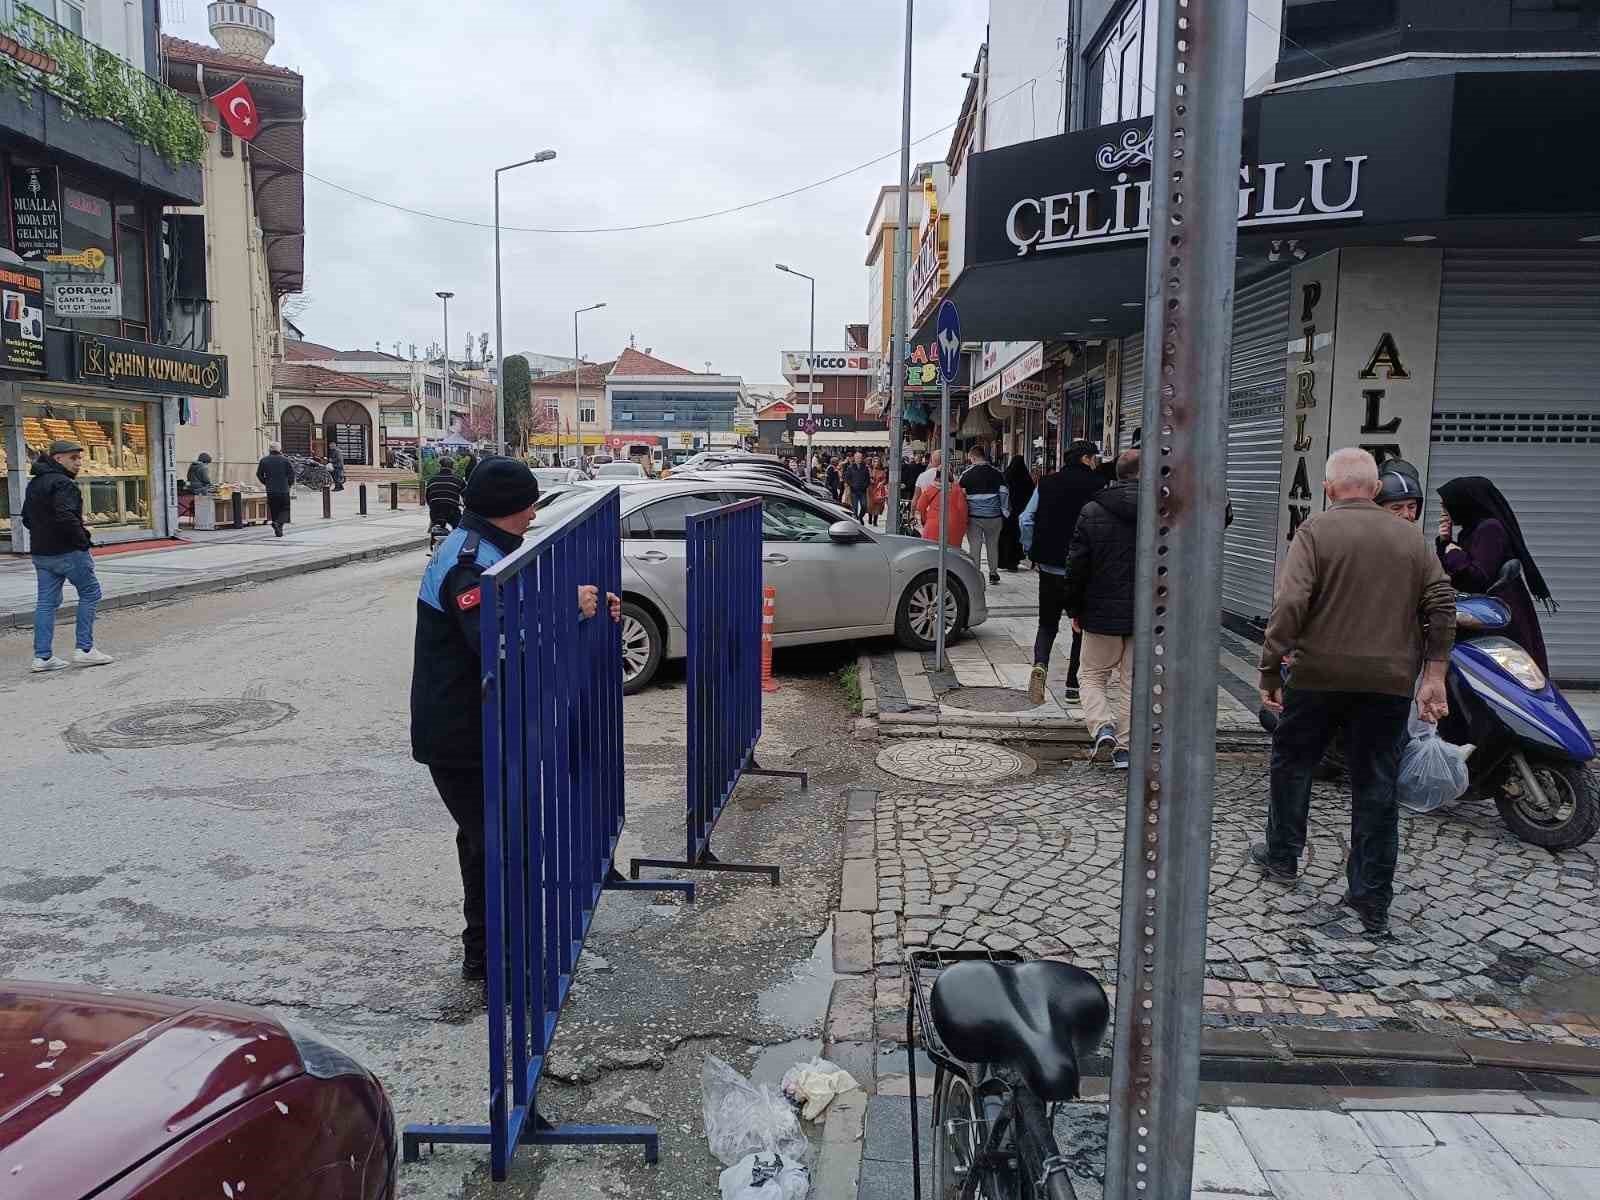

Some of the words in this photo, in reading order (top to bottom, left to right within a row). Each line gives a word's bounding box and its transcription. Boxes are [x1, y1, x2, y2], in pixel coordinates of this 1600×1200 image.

[14, 197, 57, 211] MUALLA
[17, 214, 41, 226] MODA
[17, 226, 59, 240] GELİNLİK
[58, 286, 113, 296] ÇORAPÇI
[109, 349, 145, 380] ŞAHİN
[148, 356, 201, 385] KUYUMCU
[806, 354, 846, 369] vicco
[1287, 281, 1321, 545] PIRLAN
[798, 417, 845, 428] GNCEL
